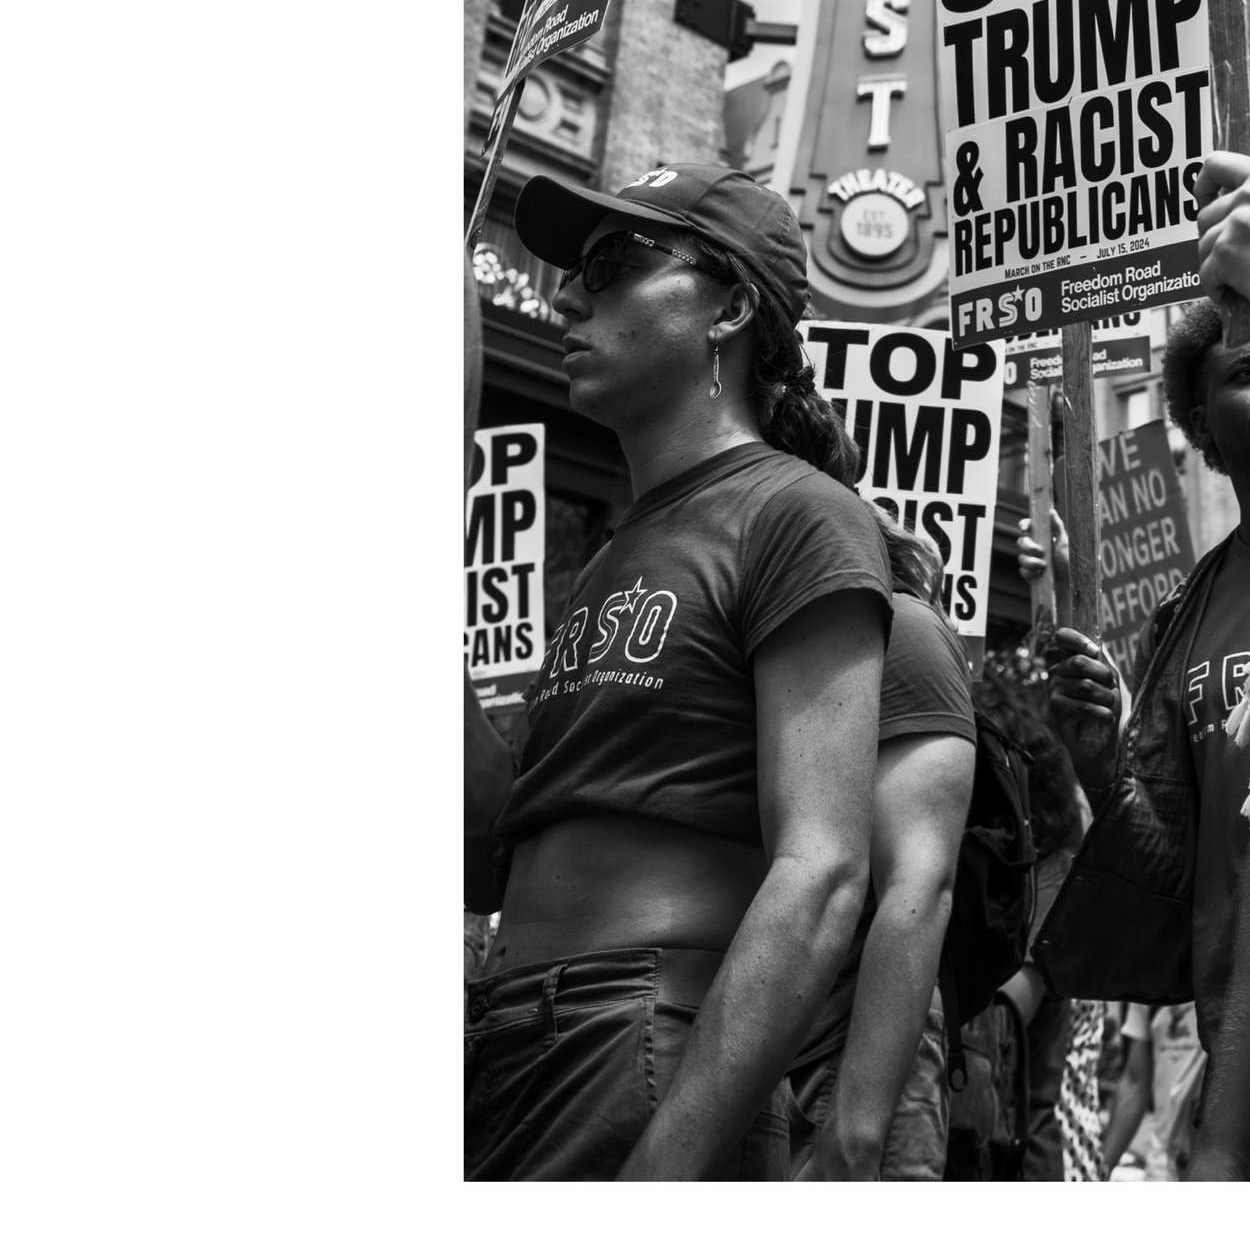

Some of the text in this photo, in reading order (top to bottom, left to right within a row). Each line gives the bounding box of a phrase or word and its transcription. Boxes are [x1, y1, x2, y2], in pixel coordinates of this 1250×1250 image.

[536, 9, 599, 55] Organization
[953, 140, 984, 218] &
[1004, 69, 1210, 204] RACIST
[827, 168, 926, 209] THEATER
[954, 161, 1202, 278] REPUBLICANS
[1004, 266, 1030, 280] MARCH
[1031, 265, 1041, 275] ON
[1042, 260, 1056, 271] THE
[1056, 254, 1071, 267] RNC
[1096, 247, 1116, 260] JULY
[1117, 243, 1129, 255] 15,
[1129, 238, 1151, 251] 2024
[1060, 260, 1161, 297] Freedom Road
[1061, 273, 1201, 314] Socialist Organizatio
[806, 326, 998, 401] TOP
[1029, 353, 1063, 369] Freed
[831, 397, 992, 495] UMP
[1099, 468, 1167, 527] AN NO
[1099, 516, 1180, 579] ONGER
[591, 668, 664, 690] Organization
